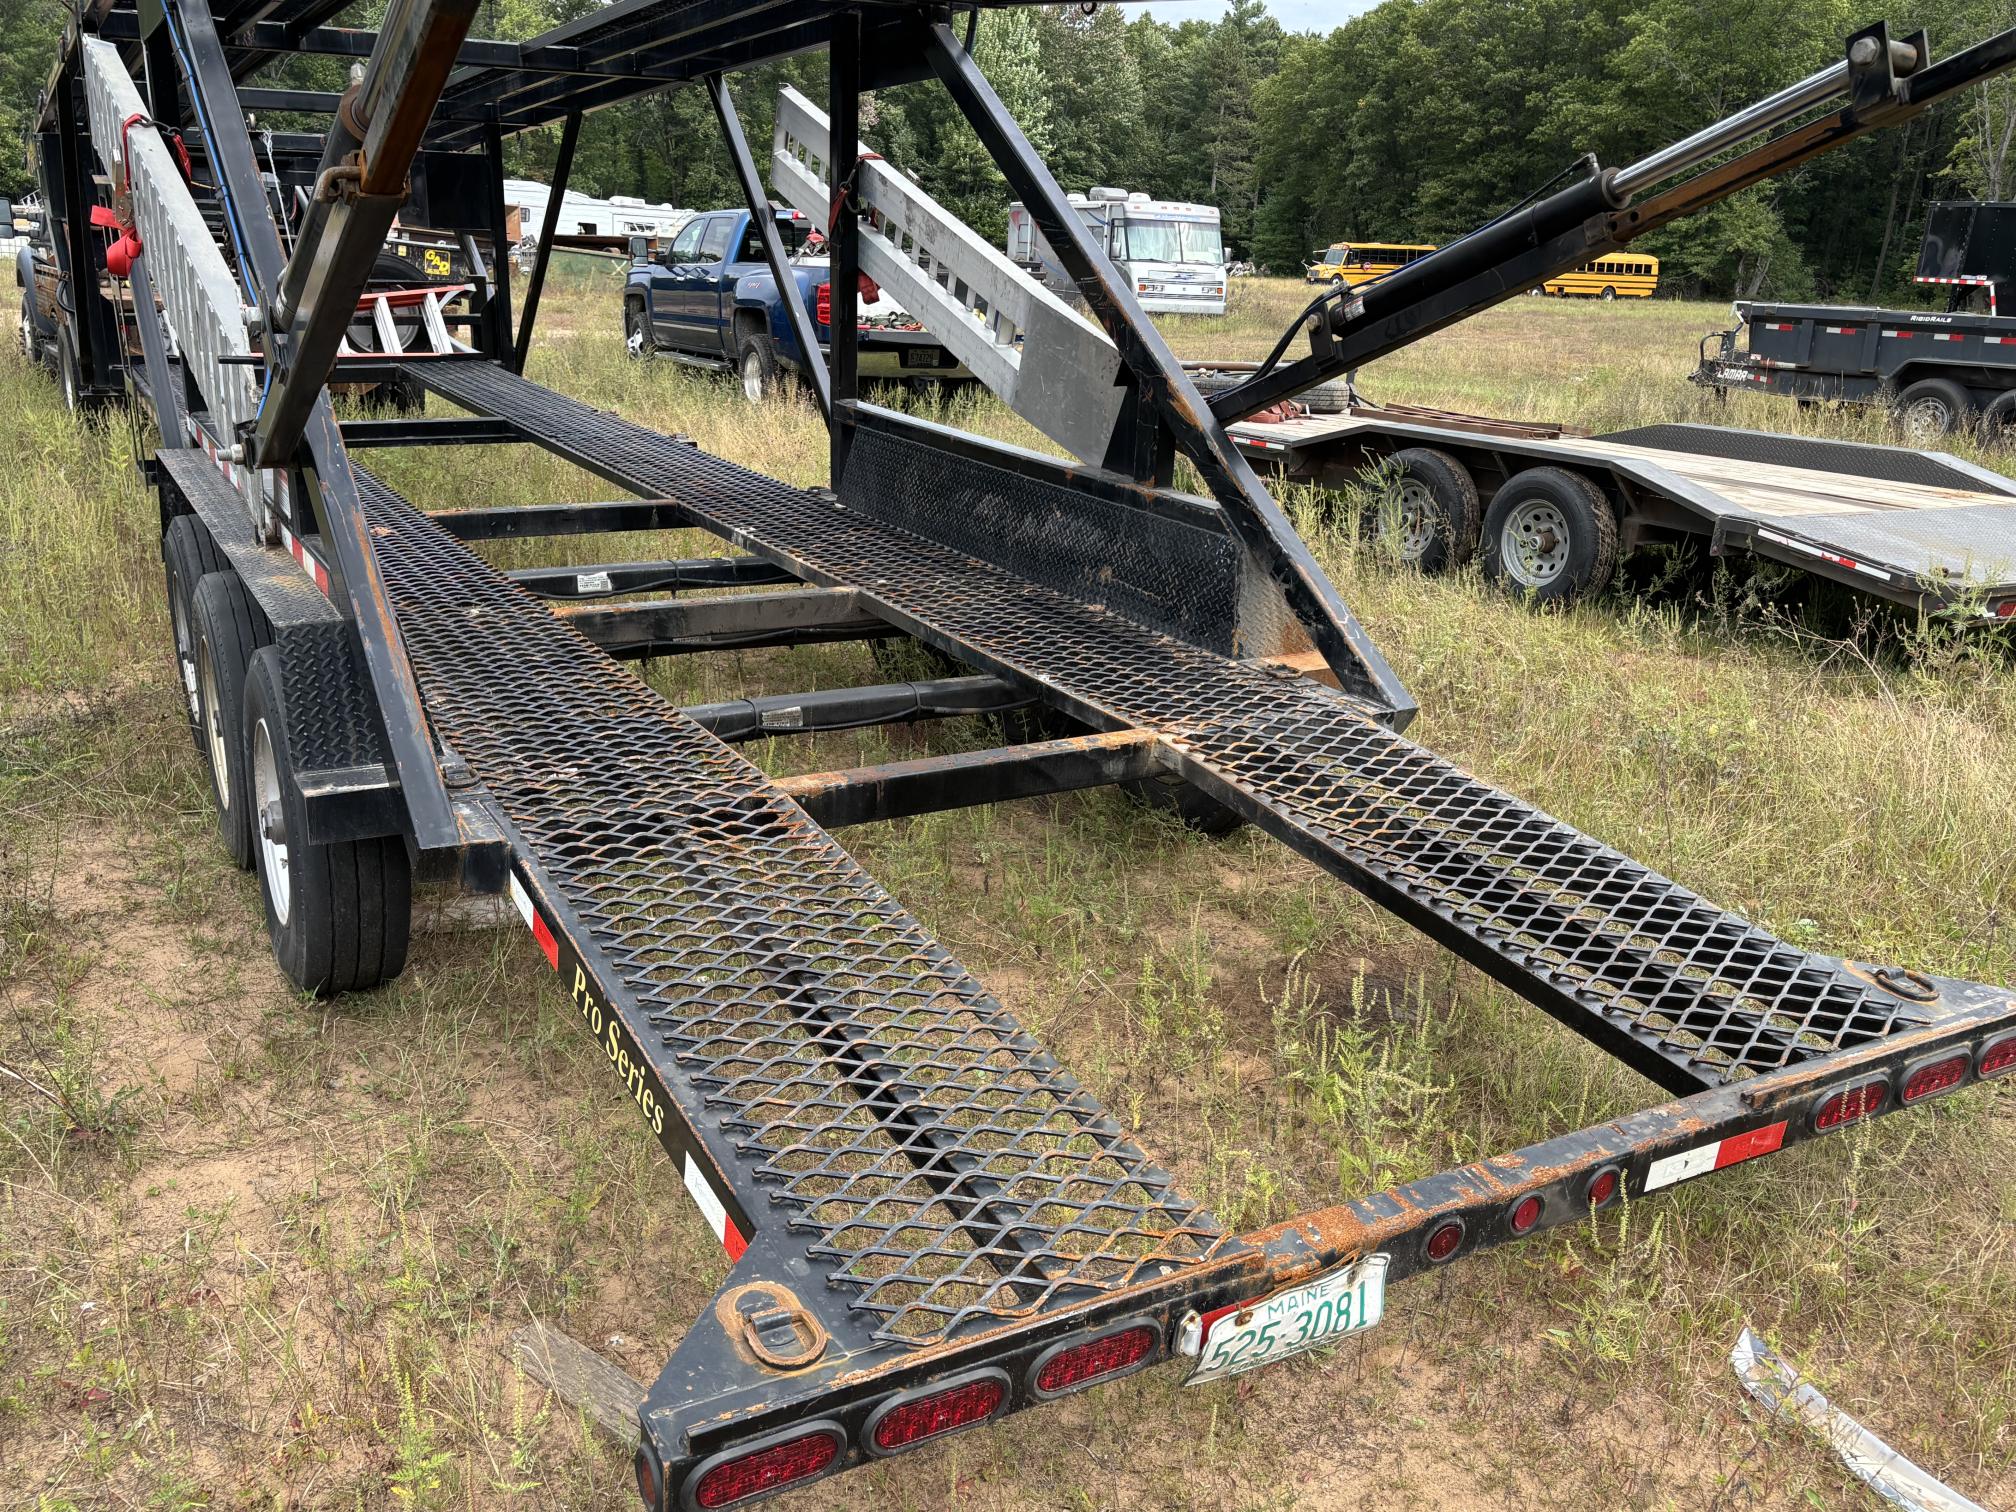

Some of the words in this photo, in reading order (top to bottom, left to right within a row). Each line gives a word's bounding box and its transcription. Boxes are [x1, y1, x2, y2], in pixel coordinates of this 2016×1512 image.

[572, 963, 602, 1034] Pro
[606, 1021, 663, 1134] Series
[1268, 1285, 1331, 1318] MAINE
